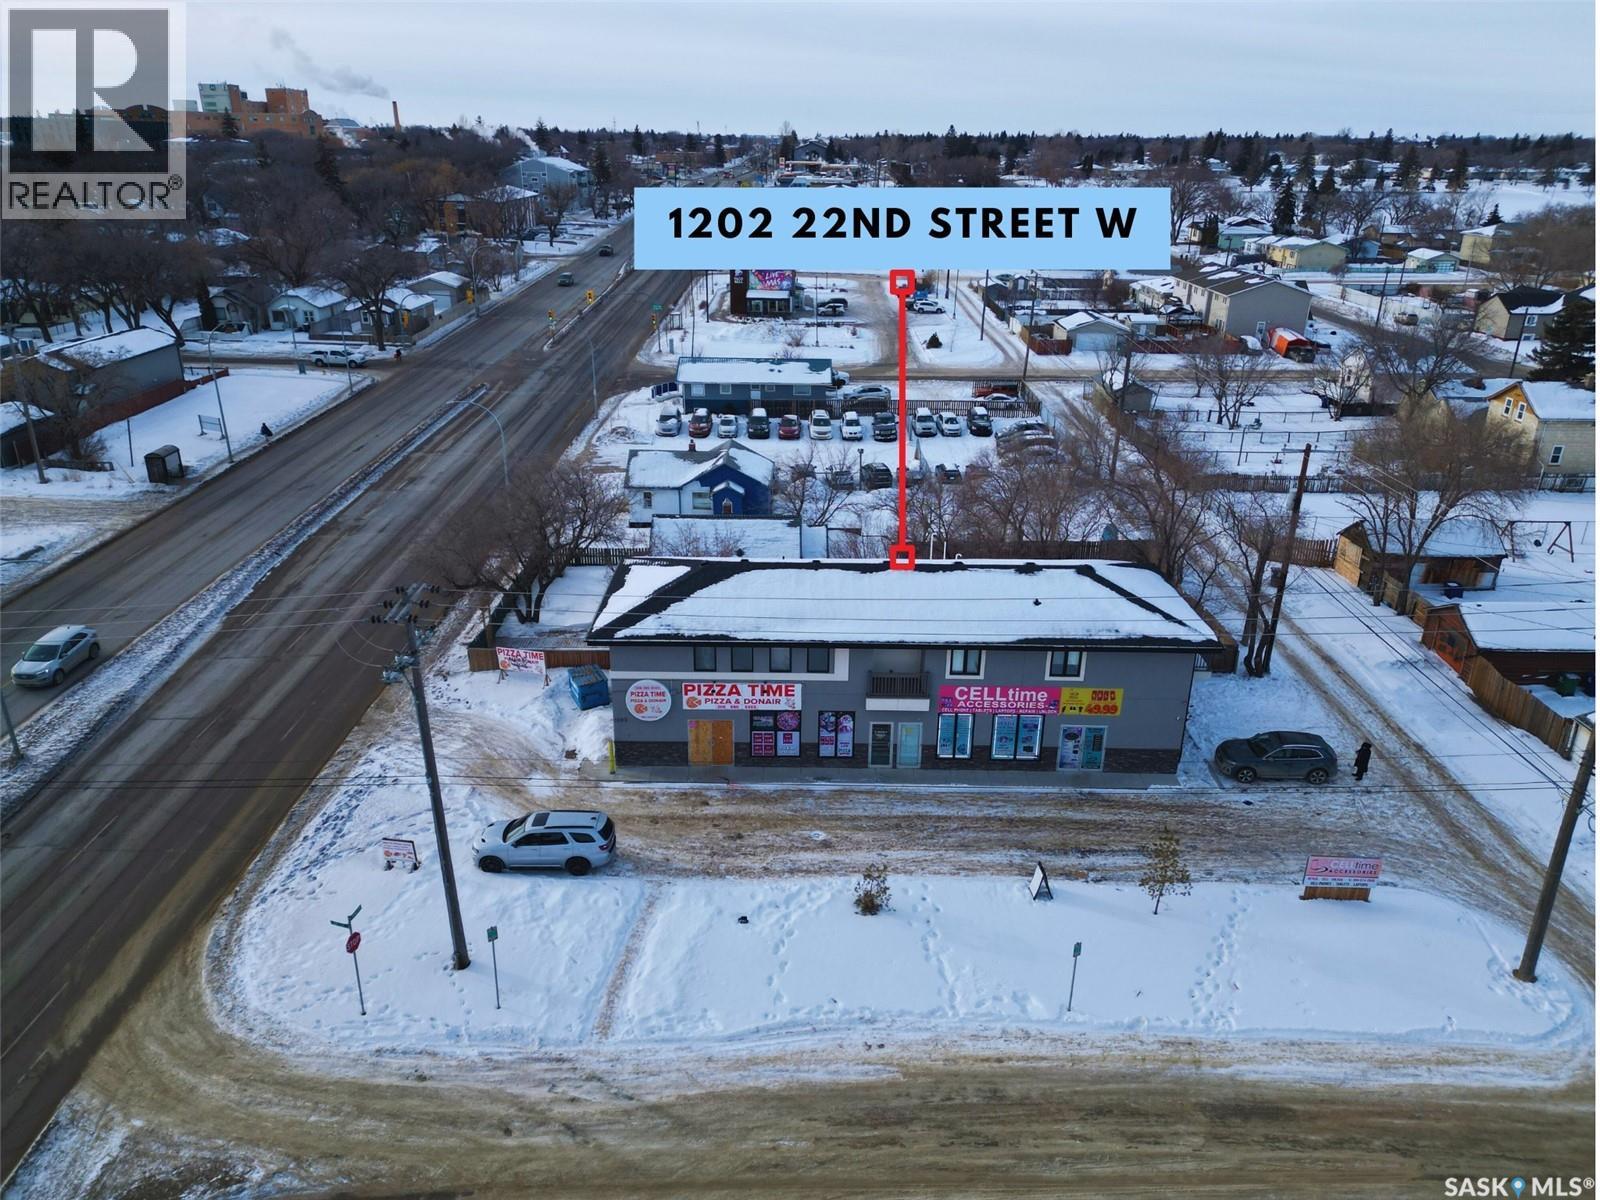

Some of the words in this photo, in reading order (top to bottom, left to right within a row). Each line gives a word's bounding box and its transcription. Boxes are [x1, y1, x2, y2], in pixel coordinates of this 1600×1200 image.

[497, 648, 521, 659] PIZZA
[523, 651, 544, 661] TIME
[683, 684, 742, 697] PIZZA
[747, 684, 796, 697] TIME
[954, 686, 1048, 702] CELLtime
[957, 700, 1046, 709] ACCESSORIES
